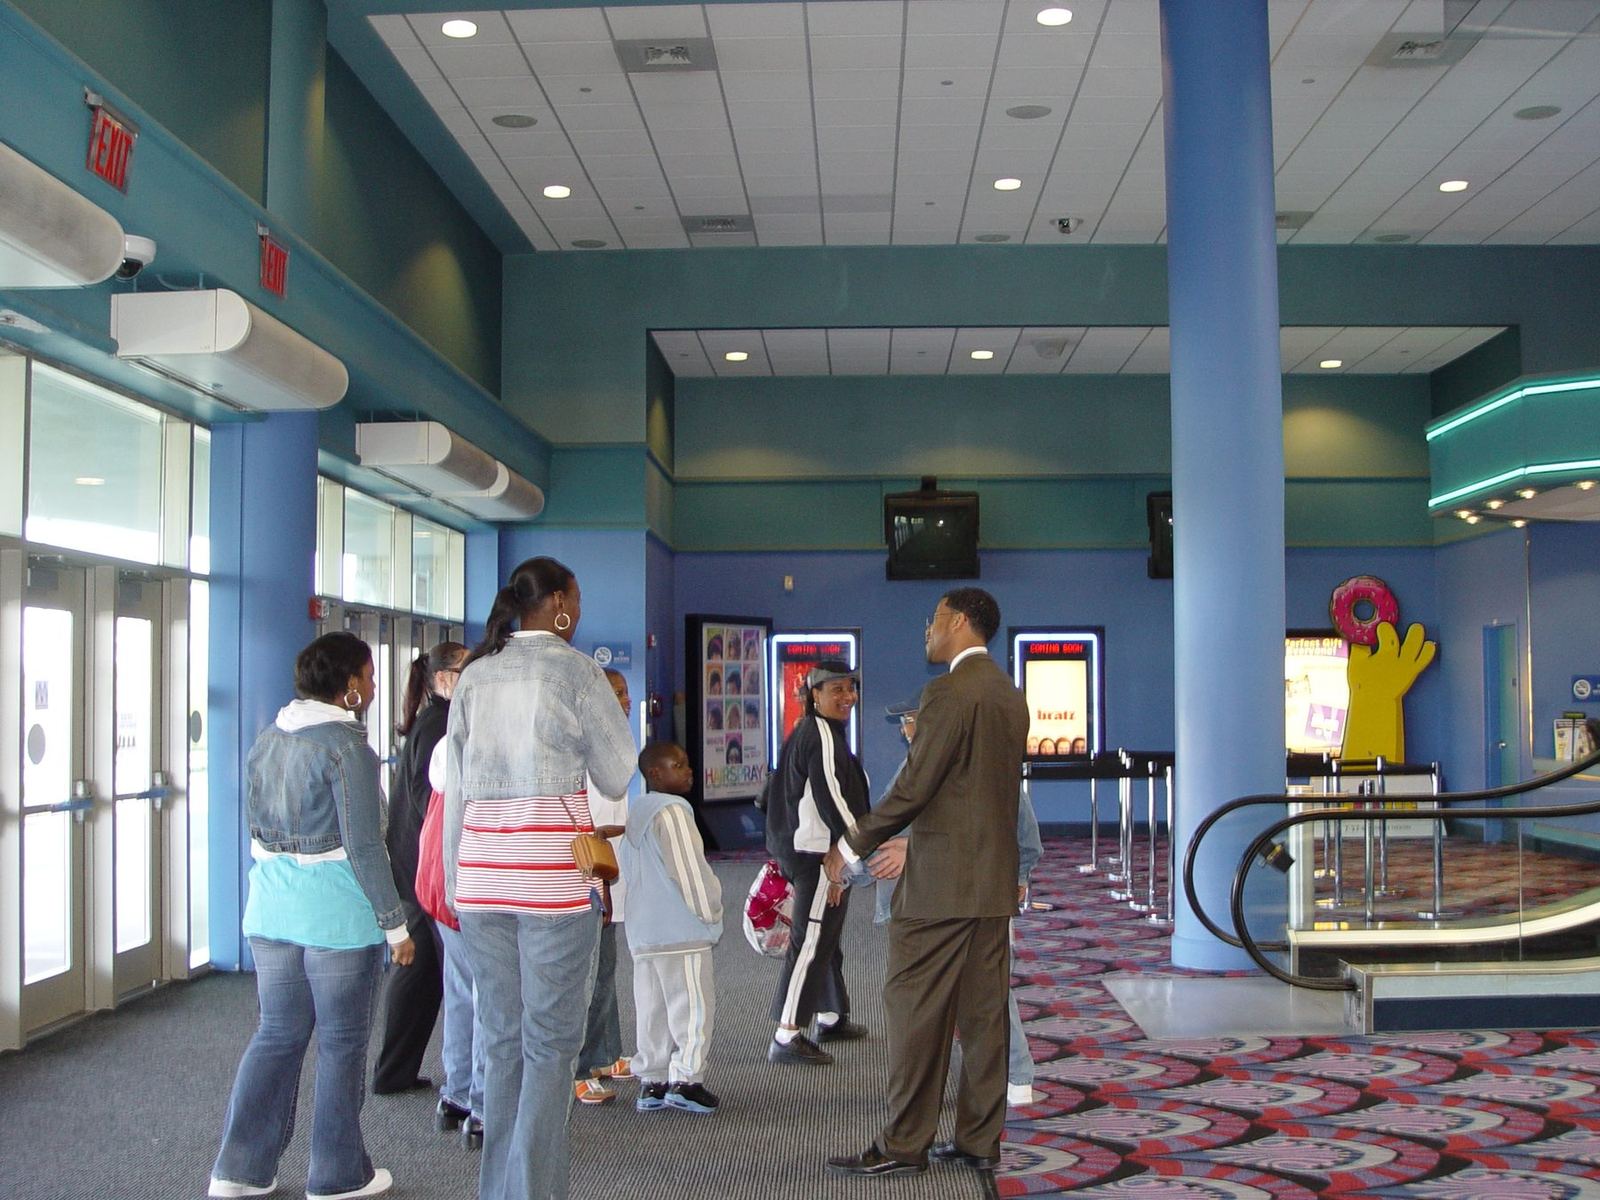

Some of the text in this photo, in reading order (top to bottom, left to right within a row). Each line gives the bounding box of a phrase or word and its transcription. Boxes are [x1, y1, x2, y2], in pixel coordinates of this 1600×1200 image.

[94, 116, 133, 191] EXIT
[265, 244, 287, 297] EXIT
[1029, 643, 1084, 654] COMING SOON
[704, 763, 765, 785] HAIRSPRAY
